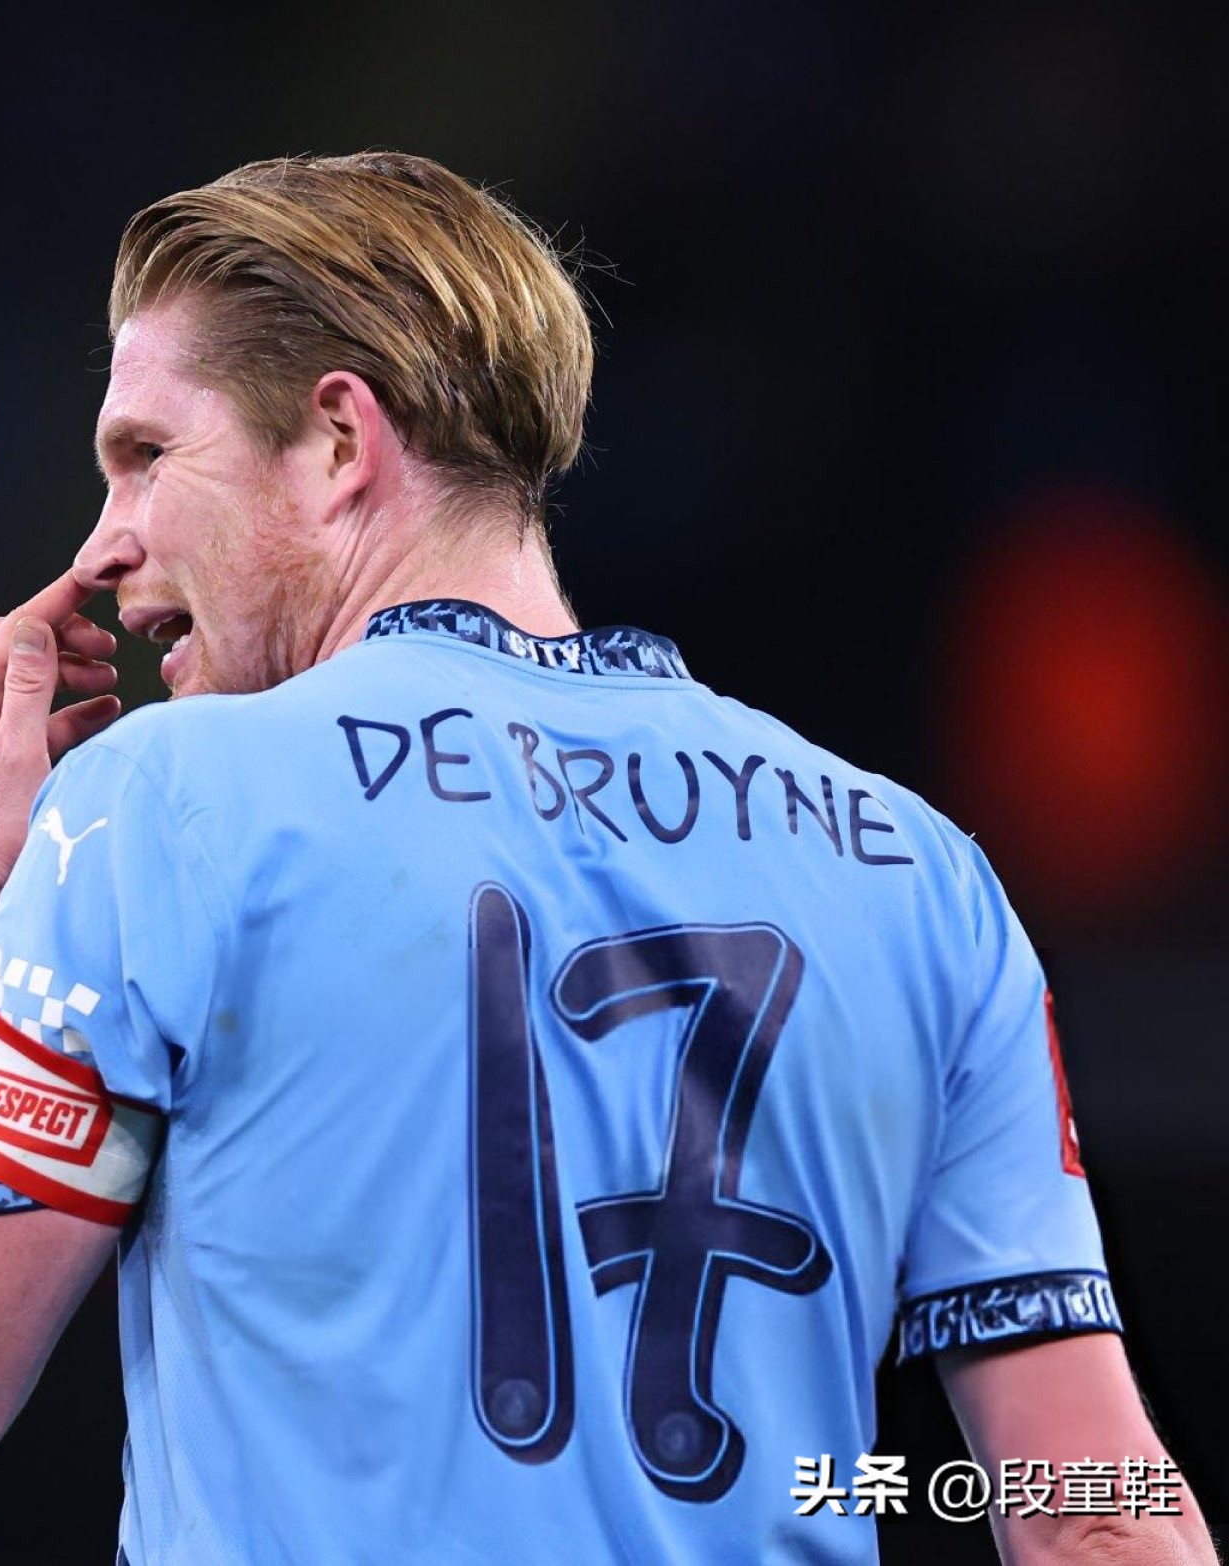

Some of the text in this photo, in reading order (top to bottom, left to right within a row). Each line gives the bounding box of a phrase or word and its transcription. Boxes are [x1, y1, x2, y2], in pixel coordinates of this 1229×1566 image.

[509, 632, 580, 669] CITY
[337, 708, 914, 865] DE BRUYNE
[467, 880, 834, 1503] 17
